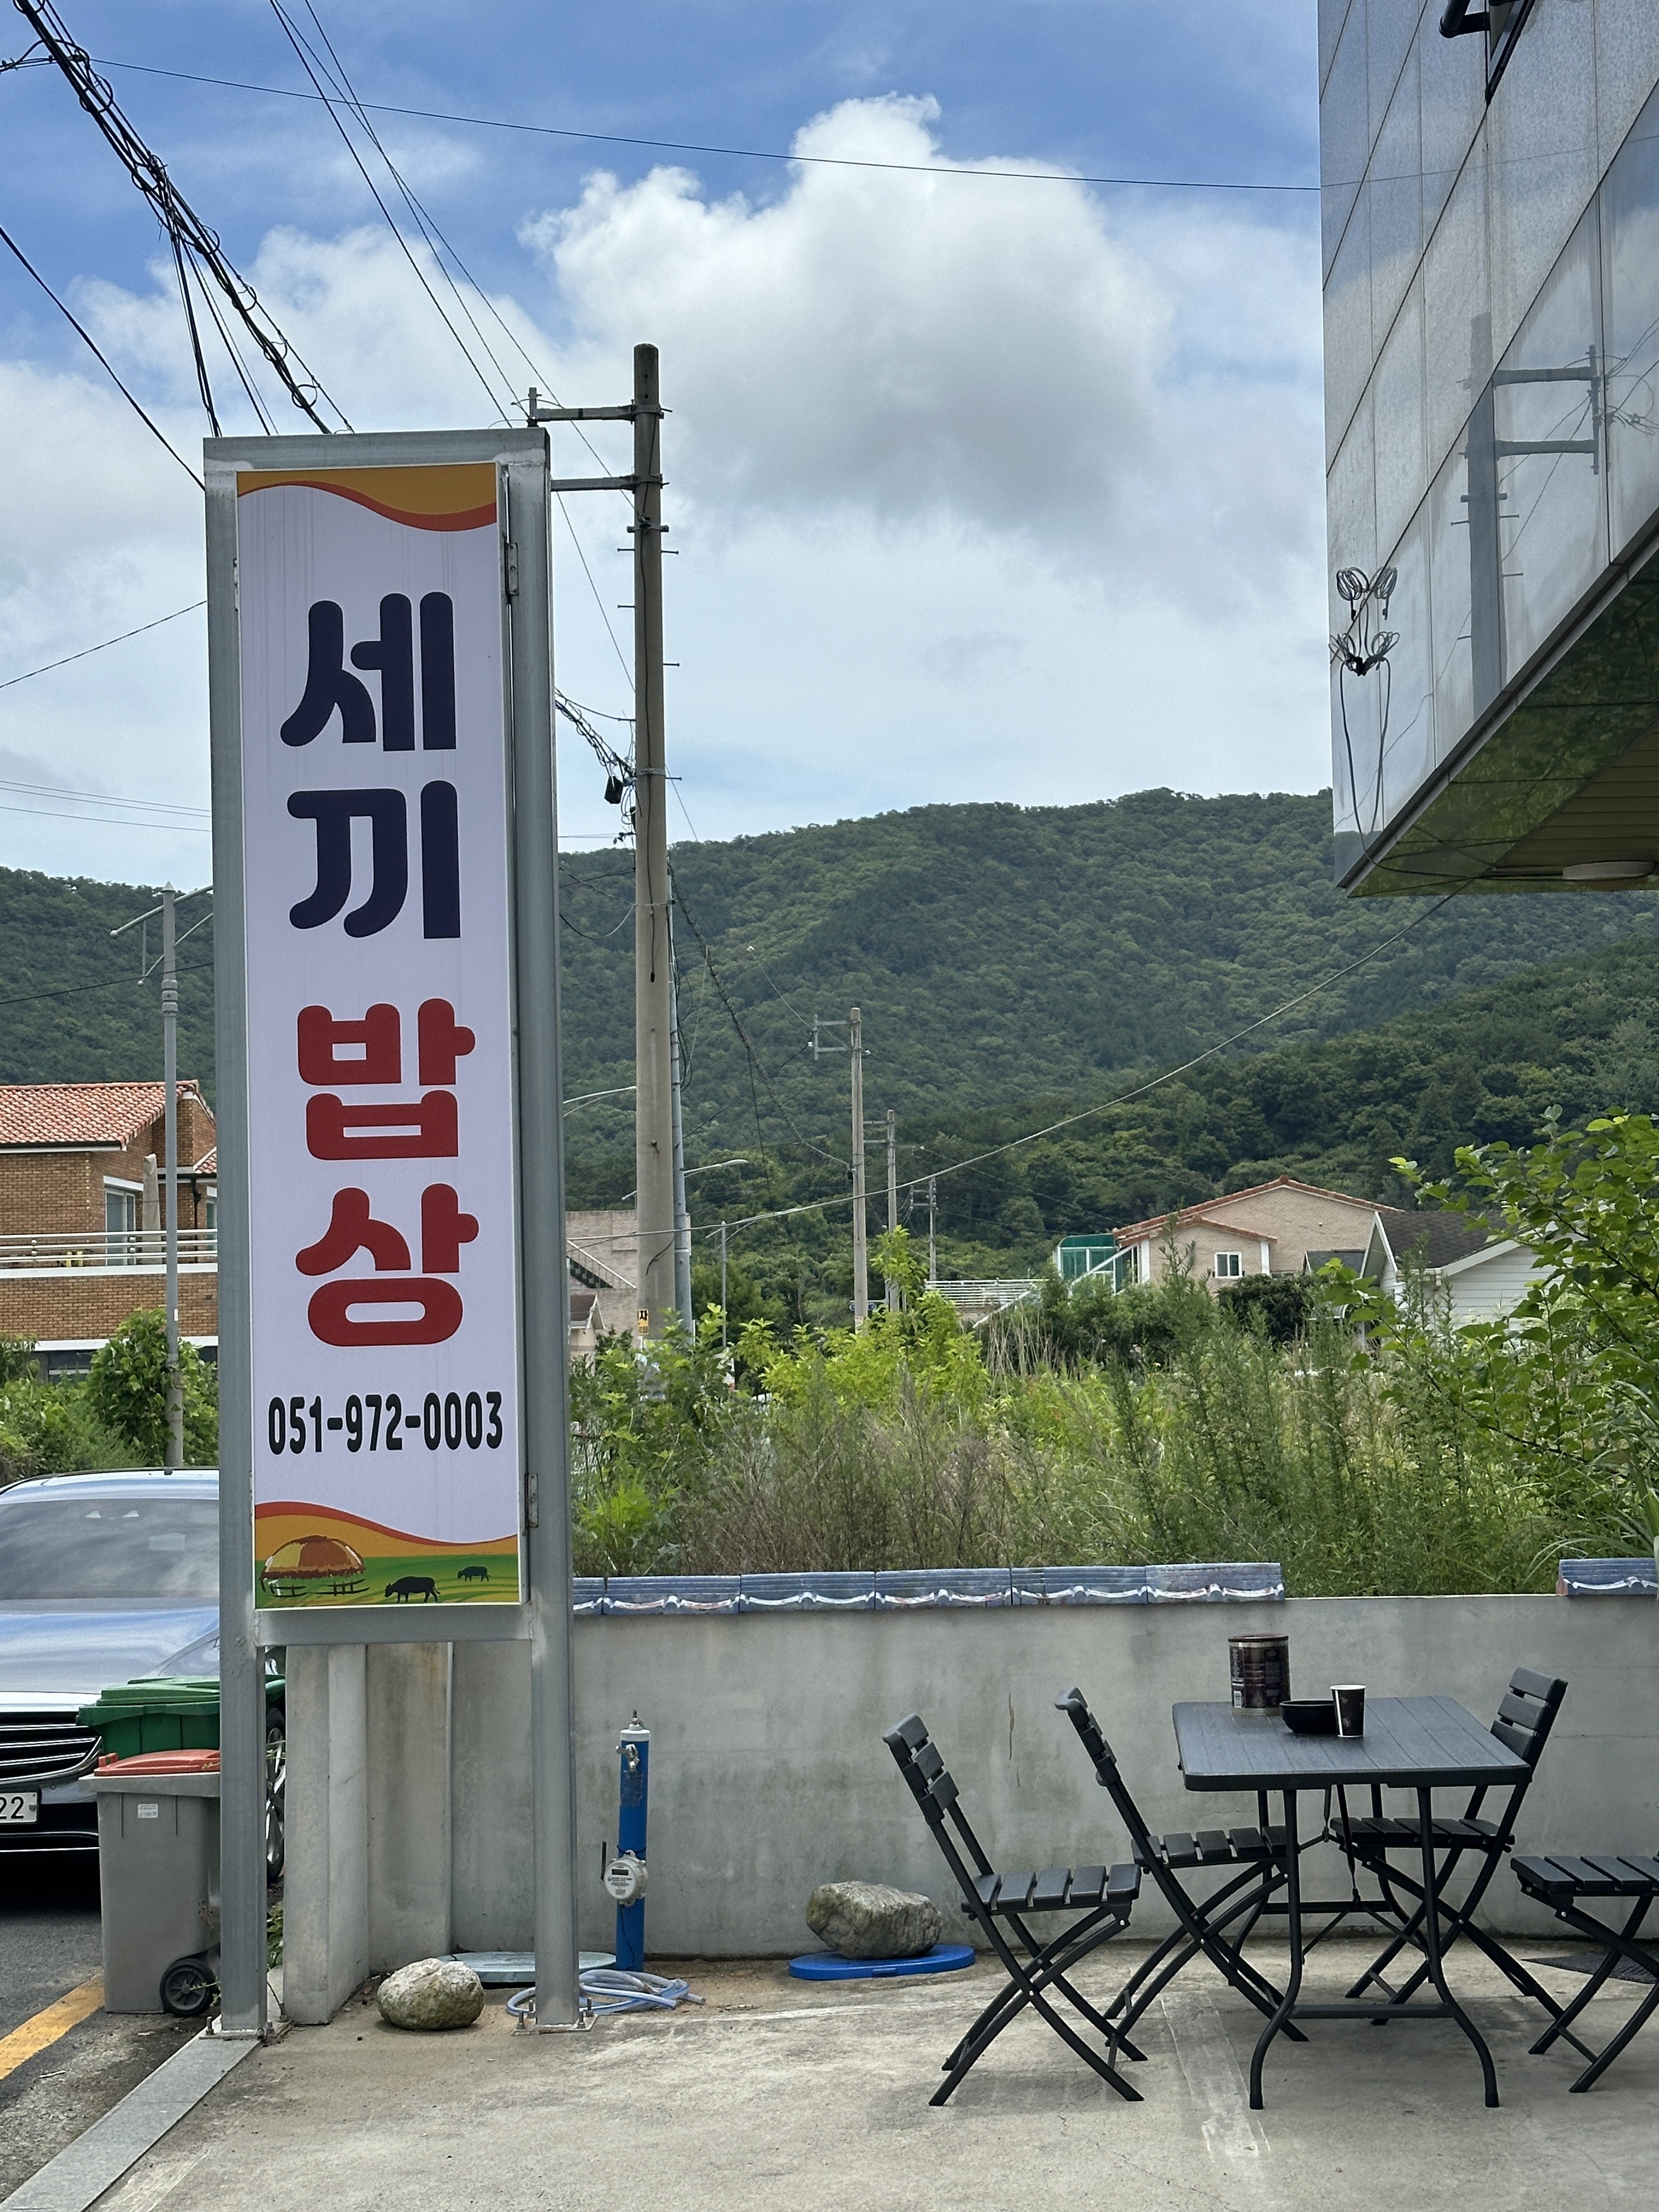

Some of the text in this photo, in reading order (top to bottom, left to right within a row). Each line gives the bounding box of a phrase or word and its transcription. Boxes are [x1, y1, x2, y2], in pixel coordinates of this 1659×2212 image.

[280, 591, 479, 1347] 세끼 밥상
[268, 1391, 503, 1455] 051-972-0003
